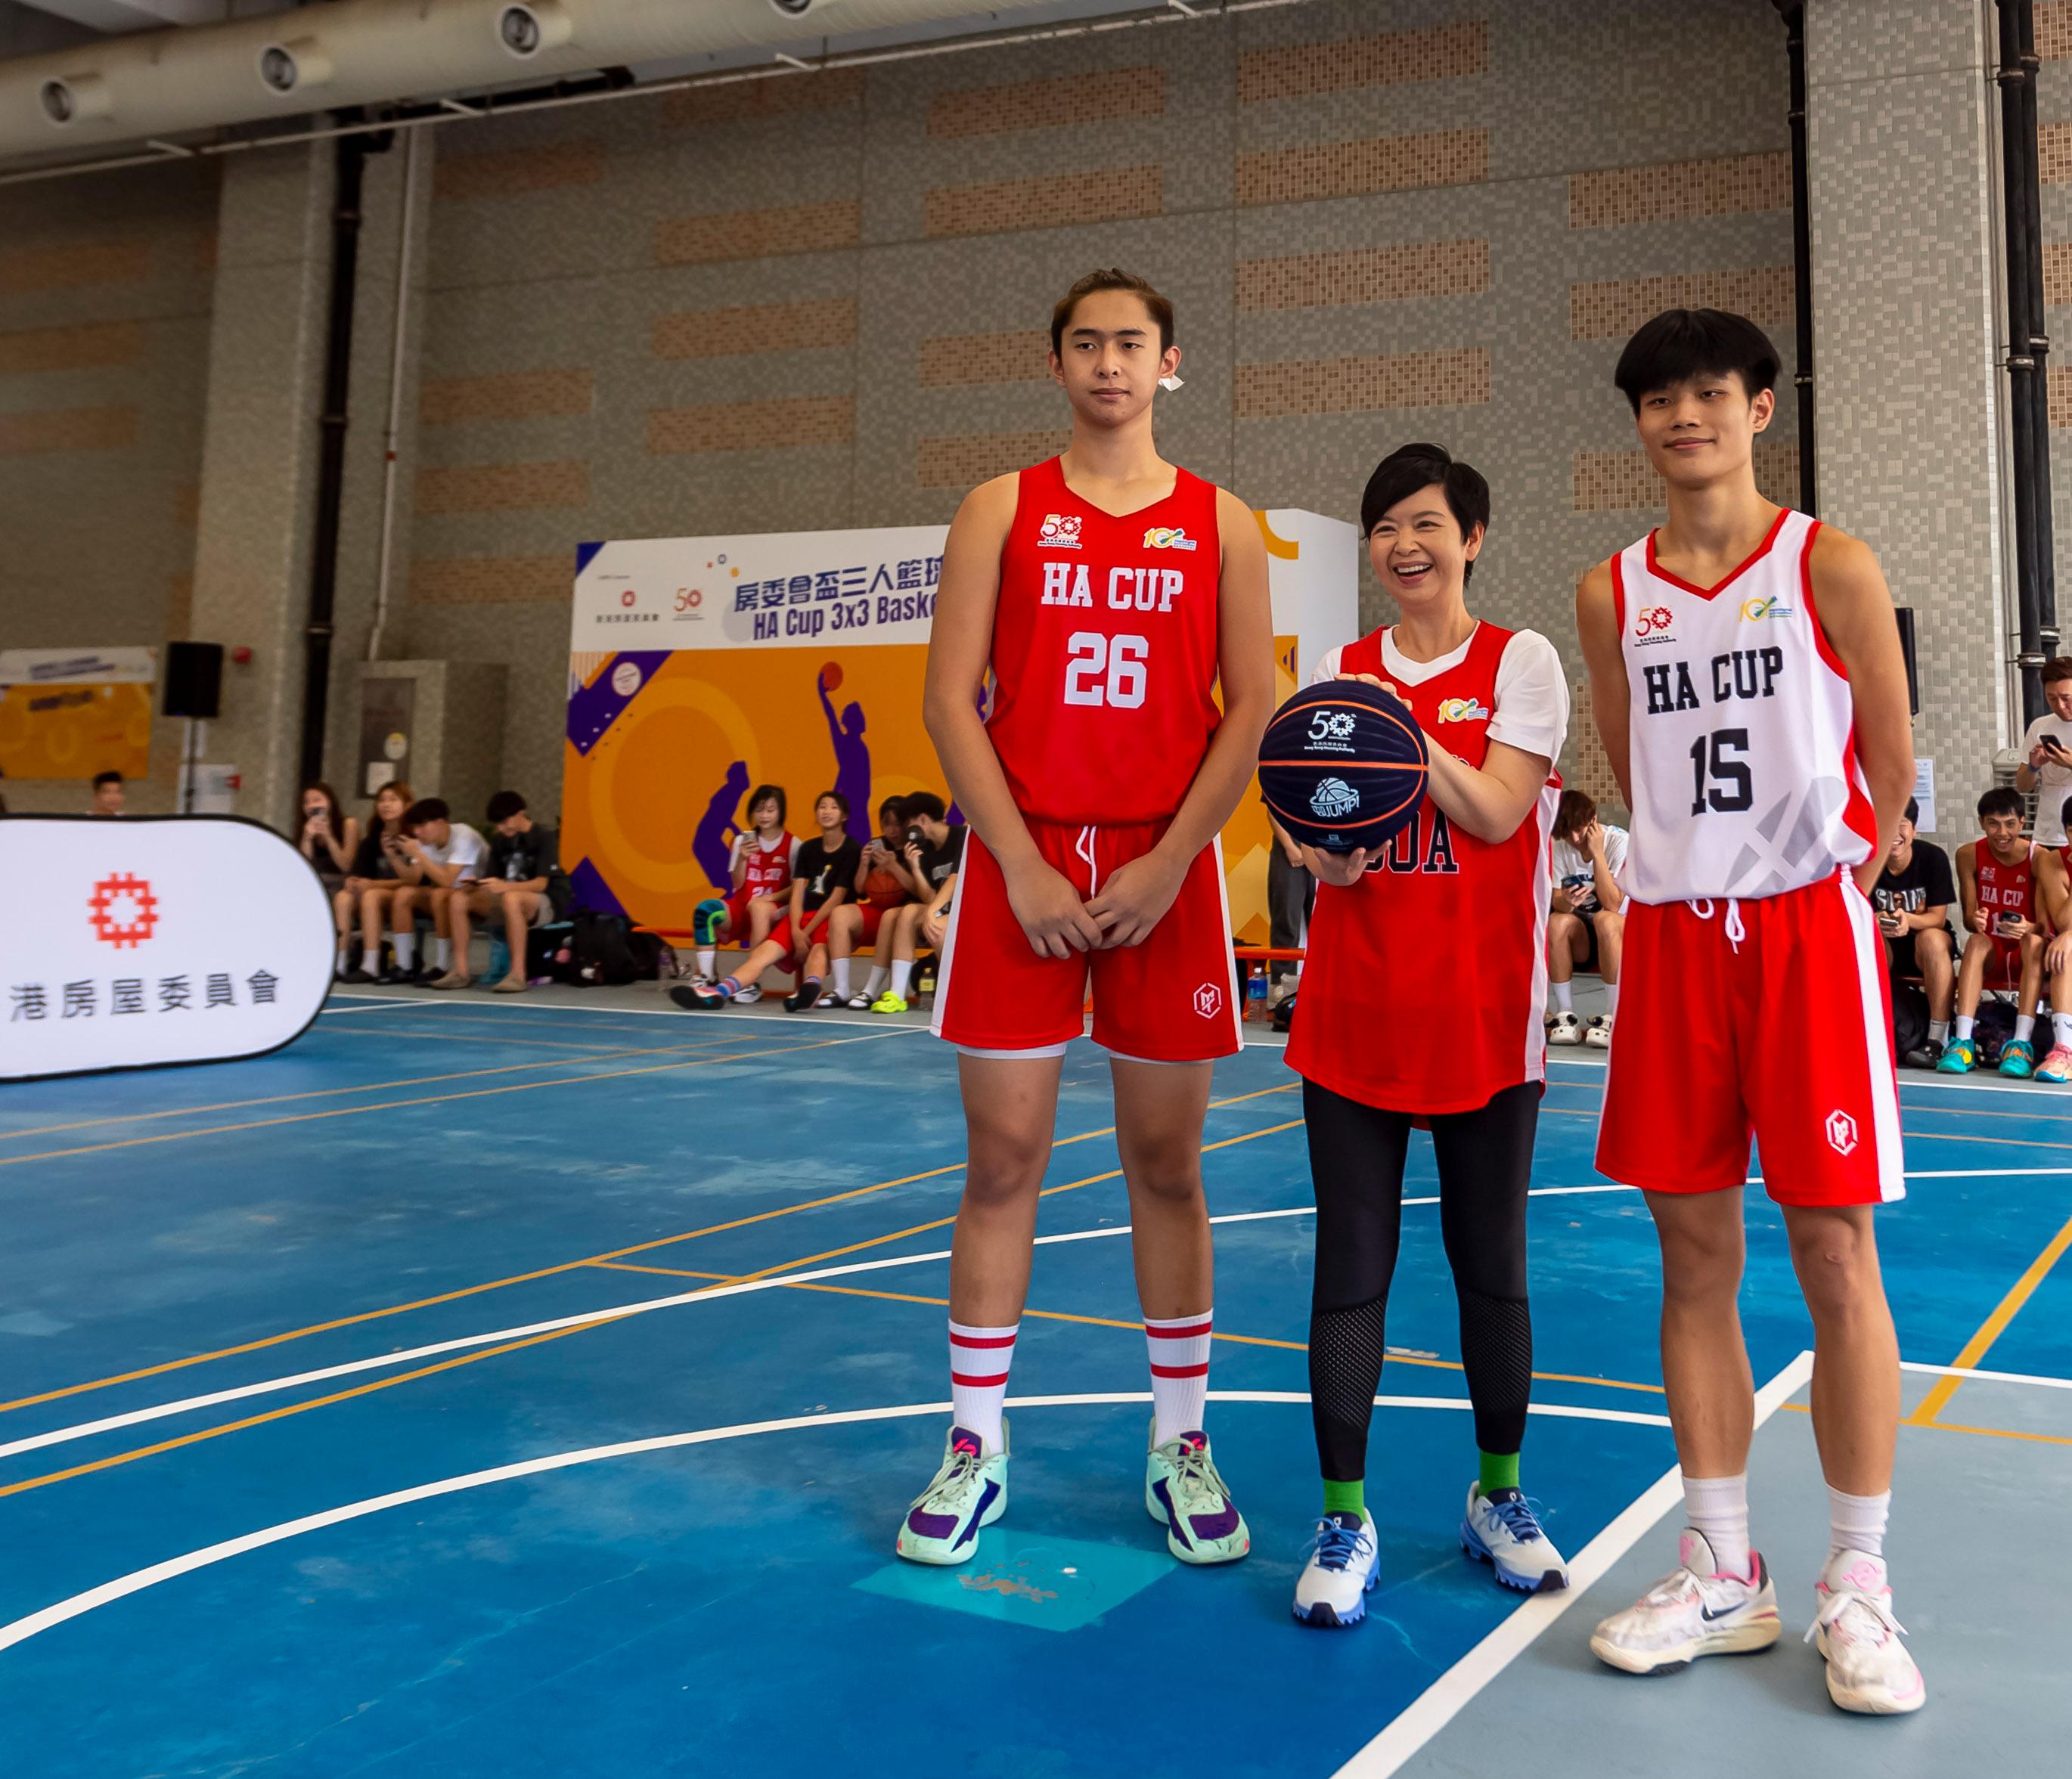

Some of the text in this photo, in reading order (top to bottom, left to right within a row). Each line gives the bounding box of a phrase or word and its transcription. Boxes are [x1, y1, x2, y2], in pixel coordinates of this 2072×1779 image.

[1041, 563, 1183, 612] HA CUP
[753, 611, 779, 640] HA
[786, 608, 824, 637] Cup
[831, 599, 870, 631] 3x3
[1063, 631, 1149, 709] 26
[1642, 646, 1783, 714] HA CUP
[1689, 727, 1754, 817] 15
[1981, 885, 1999, 903] HA
[9, 969, 281, 1022] 港房屋委員會
